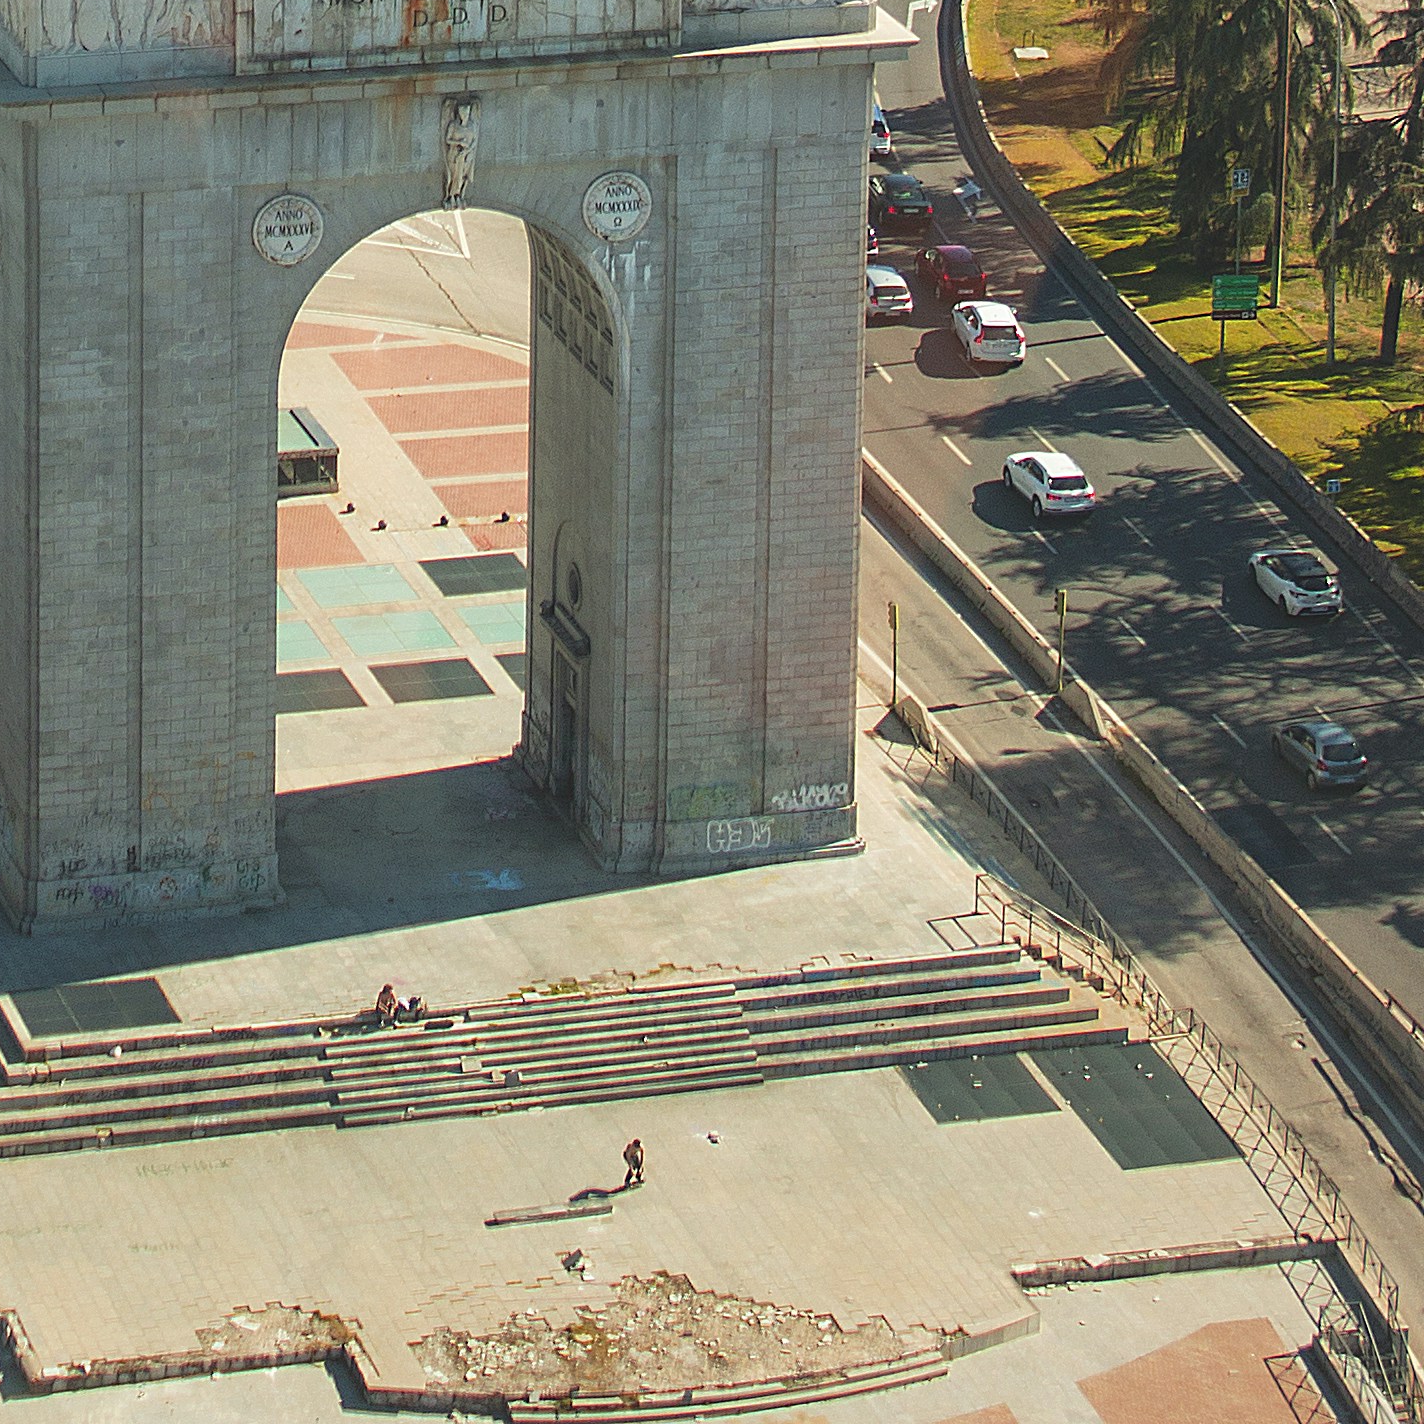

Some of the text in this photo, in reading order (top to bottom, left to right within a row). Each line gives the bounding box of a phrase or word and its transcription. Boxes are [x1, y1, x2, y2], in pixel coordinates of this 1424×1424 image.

[605, 186, 632, 198] ANNO
[275, 209, 304, 222] ANNO
[264, 221, 314, 239] MCMXXXVI
[283, 240, 294, 251] A
